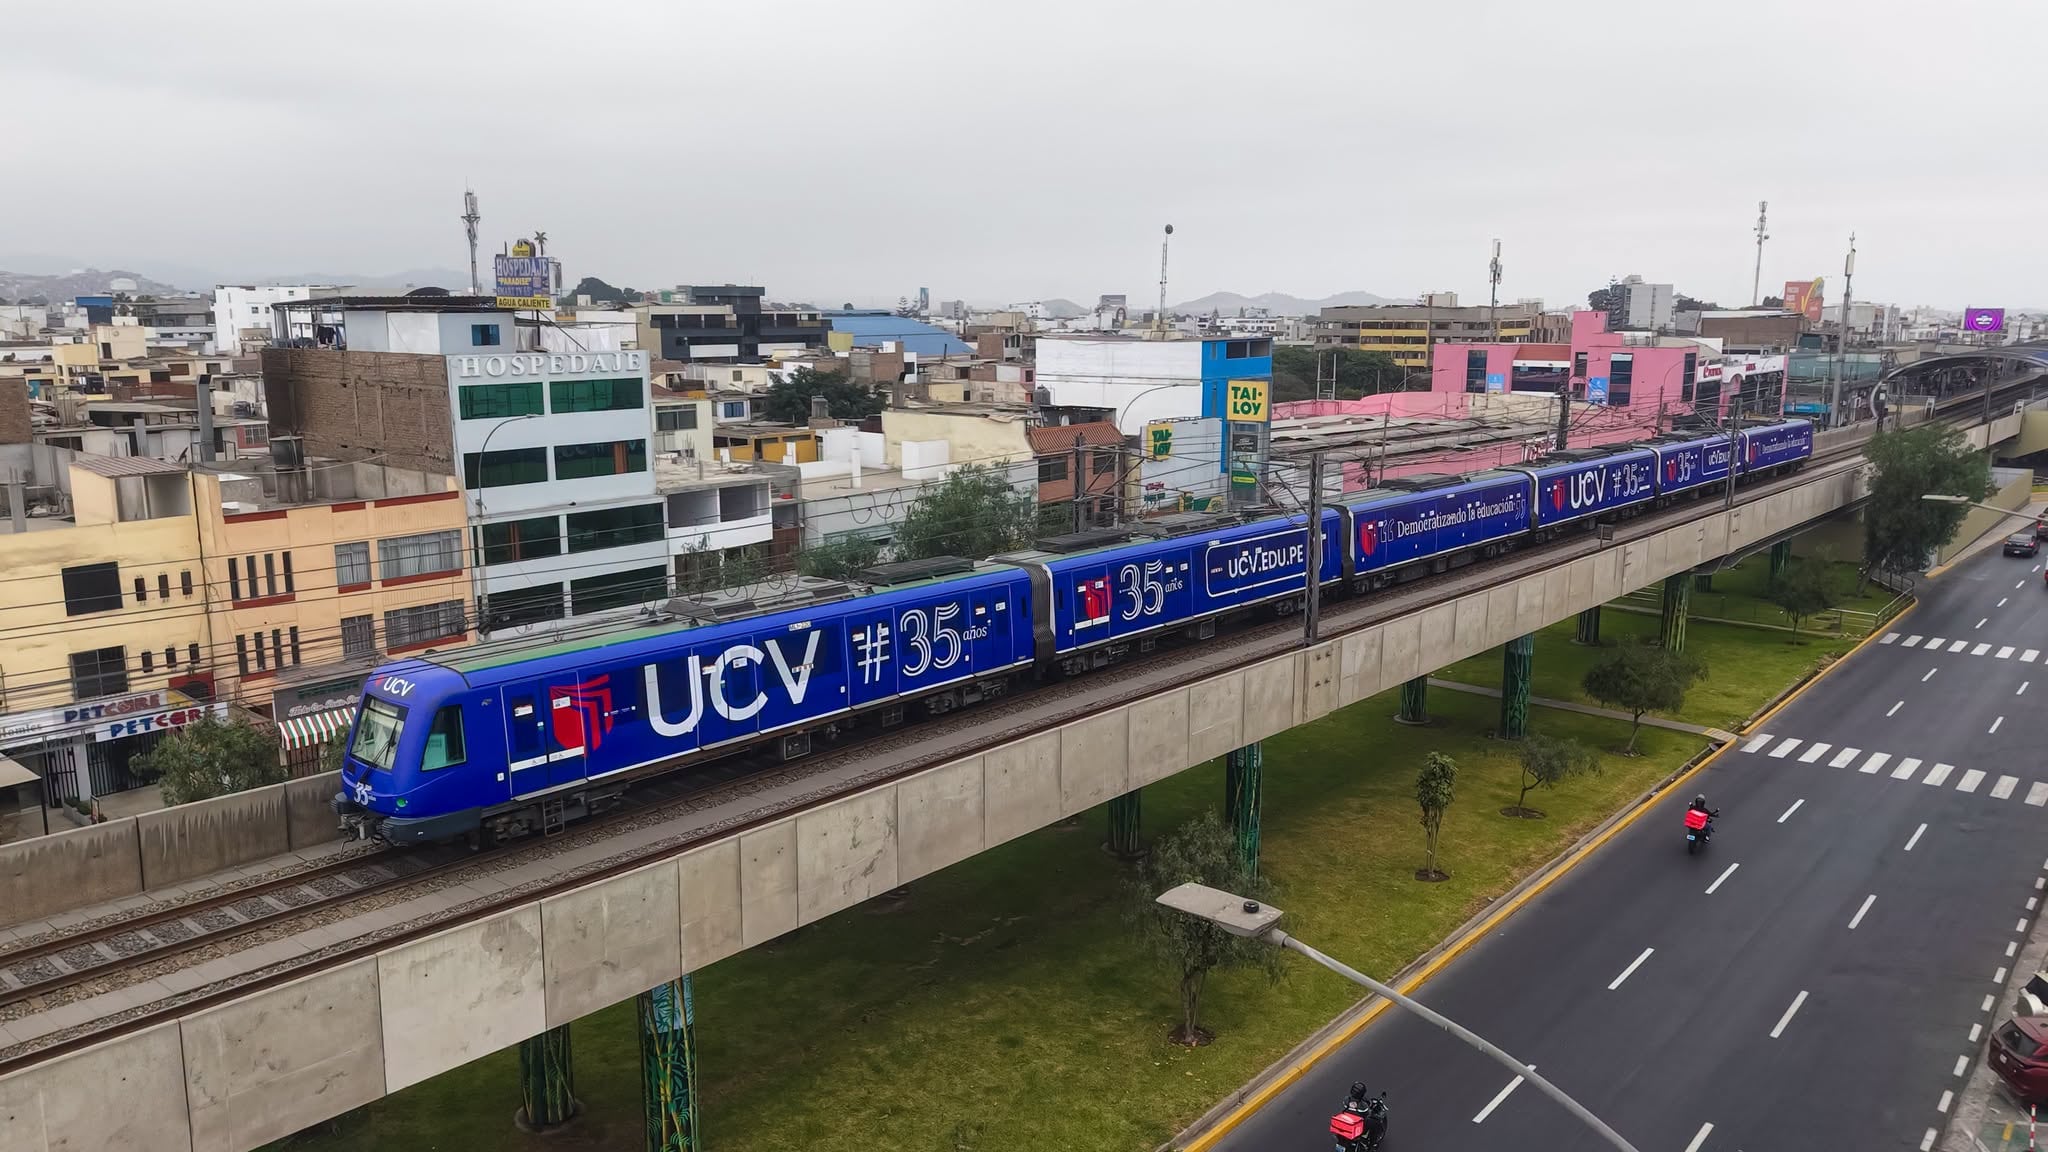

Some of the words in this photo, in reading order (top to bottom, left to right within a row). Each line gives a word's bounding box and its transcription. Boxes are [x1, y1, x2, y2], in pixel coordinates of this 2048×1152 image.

[496, 257, 549, 277] HOSPEDAJE
[499, 298, 516, 307] AGUA
[518, 299, 550, 309] CALIENTE
[458, 351, 642, 378] HOSPEDAJE
[1233, 401, 1262, 416] LOY
[1153, 442, 1172, 456] LOY
[1678, 452, 1691, 483] 35
[1570, 468, 1607, 509] UCV
[1397, 510, 1466, 538] Democratizando
[1467, 505, 1475, 521] la
[1476, 498, 1514, 519] educación
[1228, 544, 1304, 578] UCV.EDU.PE
[1120, 559, 1164, 621] 35
[963, 625, 988, 641] años
[383, 677, 415, 697] UCV
[644, 630, 821, 737] UCV
[64, 694, 160, 724] PETCARE
[110, 705, 214, 738] PETCAR
[353, 782, 371, 806] 35
